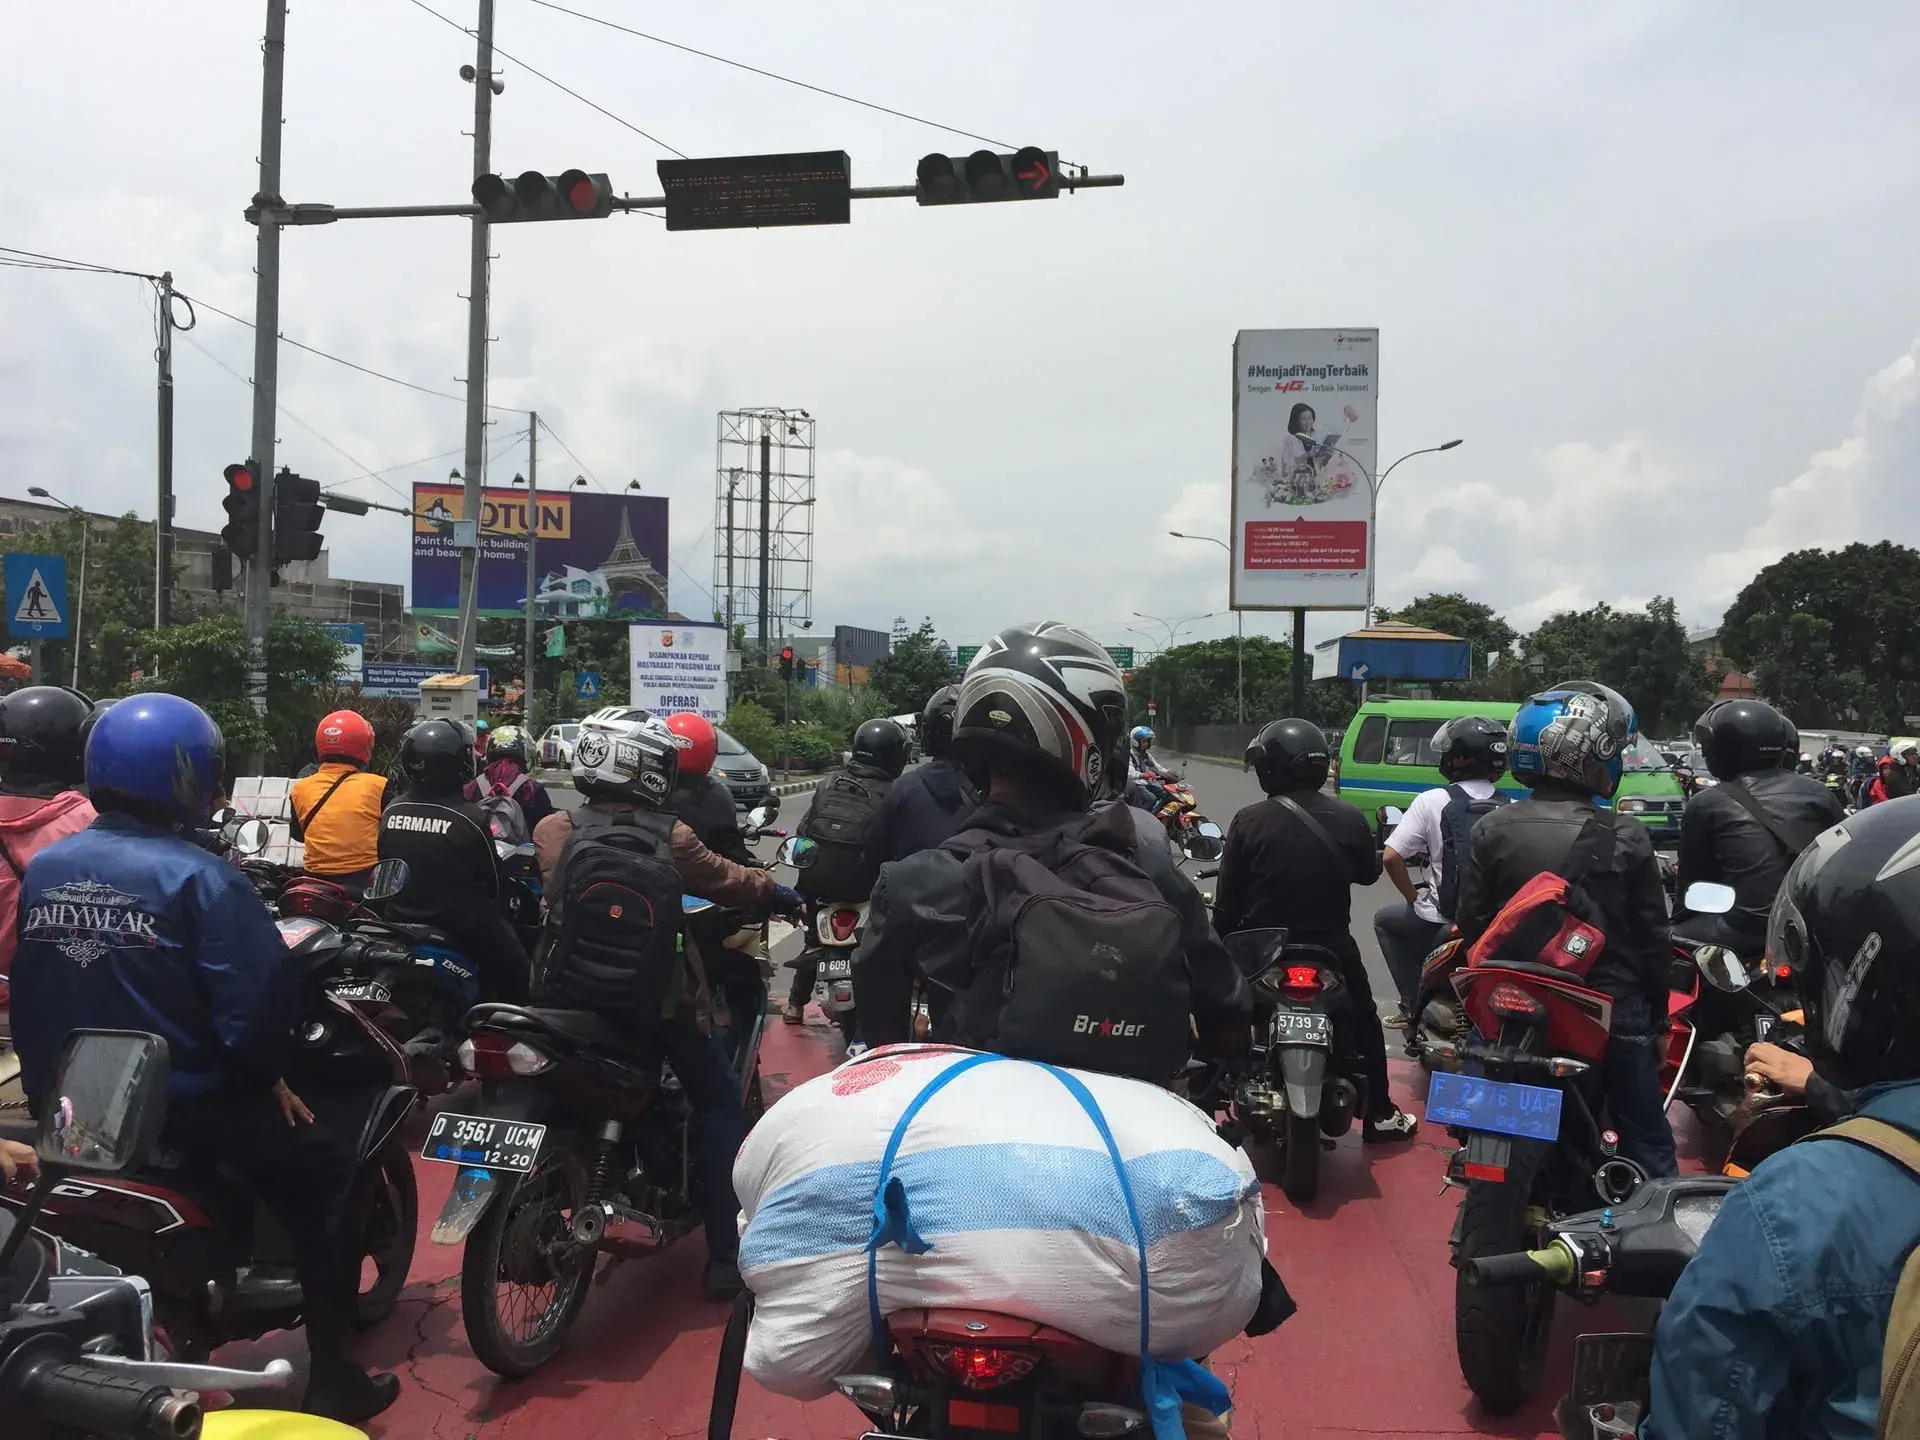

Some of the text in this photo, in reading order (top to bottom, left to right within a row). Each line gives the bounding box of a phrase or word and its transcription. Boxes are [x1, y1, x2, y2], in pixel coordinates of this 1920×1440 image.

[1247, 364, 1369, 379] #MenjadiYangTerbaik
[1247, 384, 1271, 394] Dengan
[479, 502, 564, 531] OTUN
[414, 536, 441, 546] Paint
[443, 537, 454, 546] fo
[414, 548, 435, 557] and
[484, 550, 516, 560] homes
[660, 695, 699, 707] OPERASI
[387, 815, 452, 834] GERMANY
[24, 903, 158, 938] DAILYWEAR
[1279, 1015, 1312, 1029] 5739
[432, 1117, 542, 1149] D 3561 UCM
